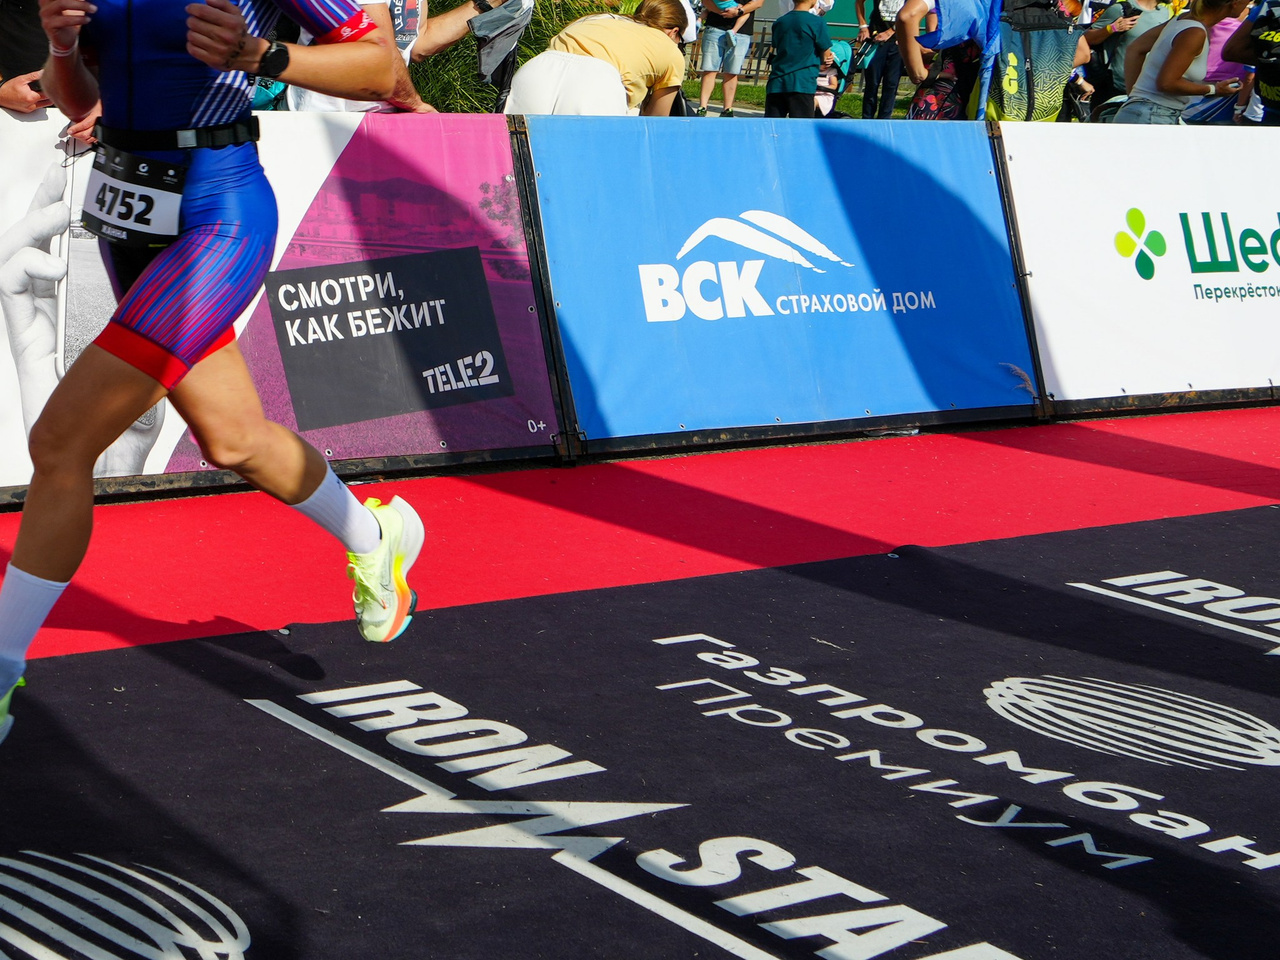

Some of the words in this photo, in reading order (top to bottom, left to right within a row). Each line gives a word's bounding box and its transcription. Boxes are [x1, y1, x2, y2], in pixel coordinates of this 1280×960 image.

[95, 182, 155, 227] 4752
[277, 271, 405, 311] СМОТРИ,
[637, 259, 776, 323] ВСК
[775, 288, 888, 315] СТРАХОВОЙ
[891, 290, 937, 314] ДОМ
[284, 313, 345, 347] КАК
[347, 299, 446, 338] БЕЖИТ
[422, 350, 500, 394] TELE2
[527, 419, 547, 433] 0+
[654, 677, 1155, 871] Премиум
[296, 679, 609, 793] IRON
[635, 836, 1024, 960] STA
